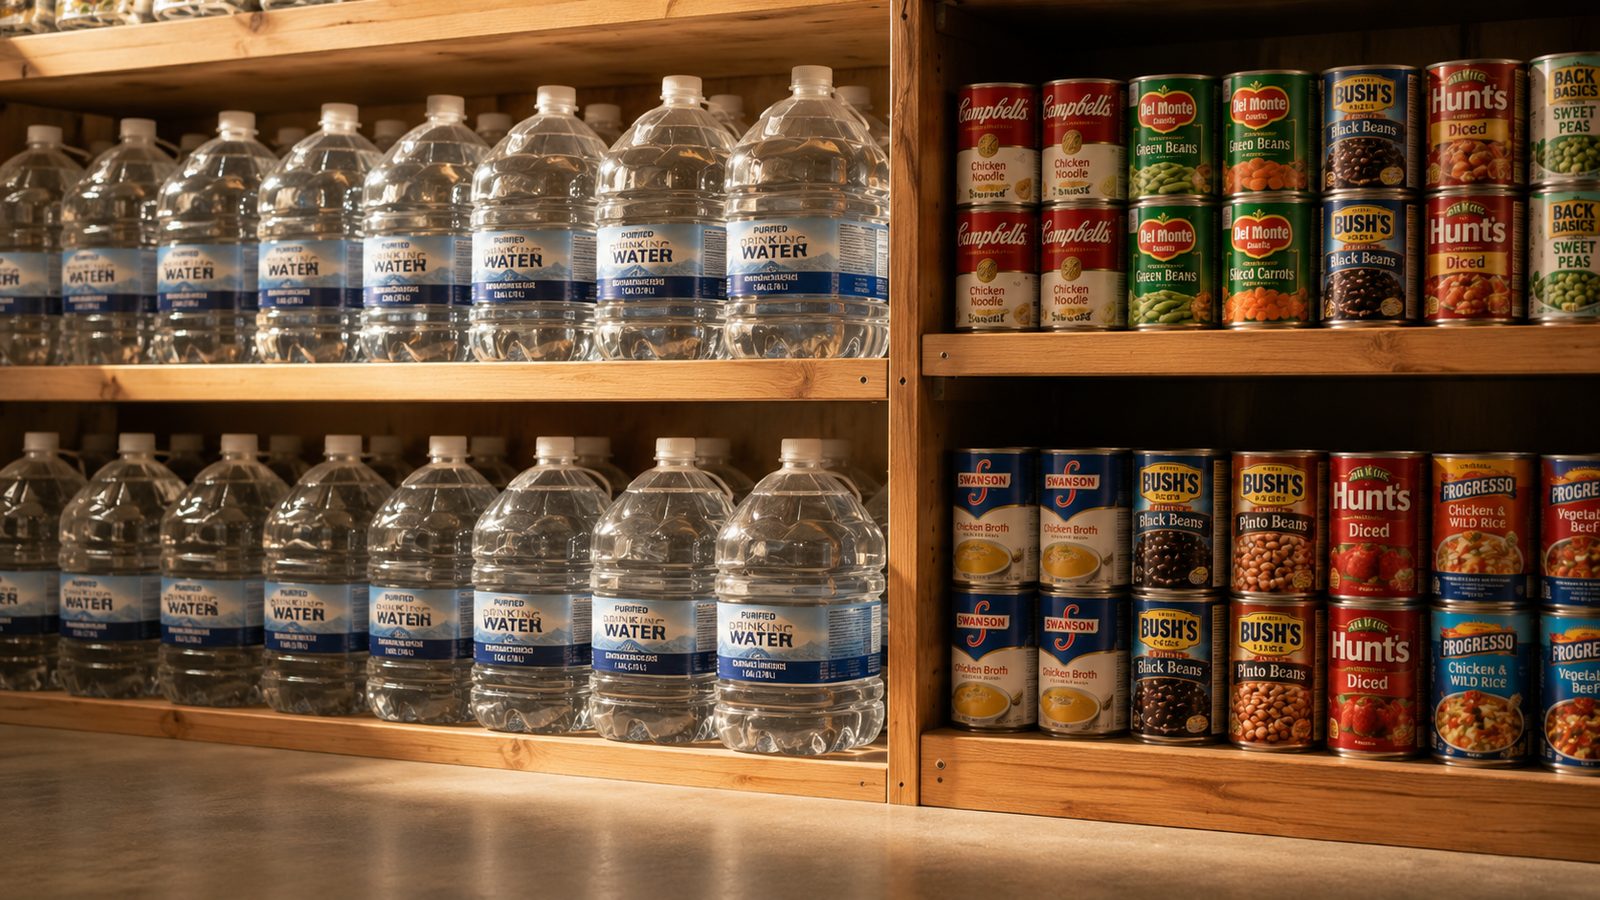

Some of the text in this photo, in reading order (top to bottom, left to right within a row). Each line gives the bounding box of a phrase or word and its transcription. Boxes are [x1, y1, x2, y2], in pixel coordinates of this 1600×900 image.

[1554, 69, 1595, 86] BACK
[1335, 83, 1393, 105] BUSH'S
[1432, 84, 1508, 114] Hunt's
[1554, 85, 1598, 99] BASICS
[959, 97, 1028, 124] Campbell's
[1043, 94, 1113, 120] Campbell's
[1141, 102, 1193, 116] Del Monte
[1233, 98, 1286, 112] Del Monte
[1553, 105, 1596, 121] SWEET
[1331, 121, 1397, 138] Black Beans
[1448, 123, 1487, 137] Diced
[1559, 121, 1591, 134] PEAS
[971, 161, 1006, 171] Chicken
[1054, 158, 1090, 168] Chicken
[972, 171, 1005, 181] Noodle
[1055, 169, 1088, 178] Noodle
[1553, 203, 1595, 220] BACK
[1334, 212, 1391, 235] BUSH'S
[1552, 219, 1595, 233] BASICS
[958, 221, 1027, 248] Campbell's
[1042, 220, 1111, 245] Campbell's
[1140, 230, 1192, 243] Del Monte
[1234, 225, 1289, 241] Del Monte
[1430, 217, 1506, 245] Hunt's
[741, 244, 808, 260] WATER
[1553, 241, 1596, 255] SWEET
[613, 248, 673, 264] WATER
[1330, 253, 1396, 268] Black Beans
[1446, 256, 1485, 269] Diced
[1558, 256, 1591, 268] PEAS
[1257, 267, 1295, 280] Carrots
[969, 286, 1005, 296] Chicken
[1053, 285, 1089, 295] Chicken
[970, 296, 1003, 306] Noodle
[1054, 295, 1088, 305] Noodle
[959, 474, 1006, 486] SWANSON
[1047, 475, 1095, 487] SWANSON
[1142, 472, 1199, 494] BUSH'S
[1242, 472, 1304, 495] BUSH'S
[1443, 478, 1513, 500] PROGRESSO
[1333, 482, 1411, 512] Hunt's
[1448, 505, 1493, 517] Chicken
[956, 522, 1009, 533] Chicken Broth
[1043, 523, 1098, 535] Chicken Broth
[1139, 515, 1203, 530] Black Beans
[1239, 515, 1308, 531] Pinto Beans
[1449, 517, 1478, 529] WILD
[1349, 523, 1390, 538] Diced
[65, 597, 113, 611] WATER
[729, 621, 793, 632] DRINKING
[958, 615, 1005, 628] SWANSON
[1046, 618, 1094, 631] SWANSON
[1140, 616, 1198, 639] BUSH'S
[604, 623, 666, 640] WATER
[1240, 620, 1301, 644] BUSH'S
[730, 630, 793, 648] WATER
[1443, 633, 1514, 656] PROGRESSO
[1332, 631, 1409, 663] Hunt's
[955, 663, 1008, 675] Chicken Broth
[1043, 667, 1097, 679] Chicken Broth
[1137, 661, 1202, 677] Black Beans
[1237, 663, 1306, 680] Pinto Beans
[1448, 662, 1495, 675] Chicken
[1347, 674, 1388, 690] Diced
[1450, 676, 1478, 688] WILD
